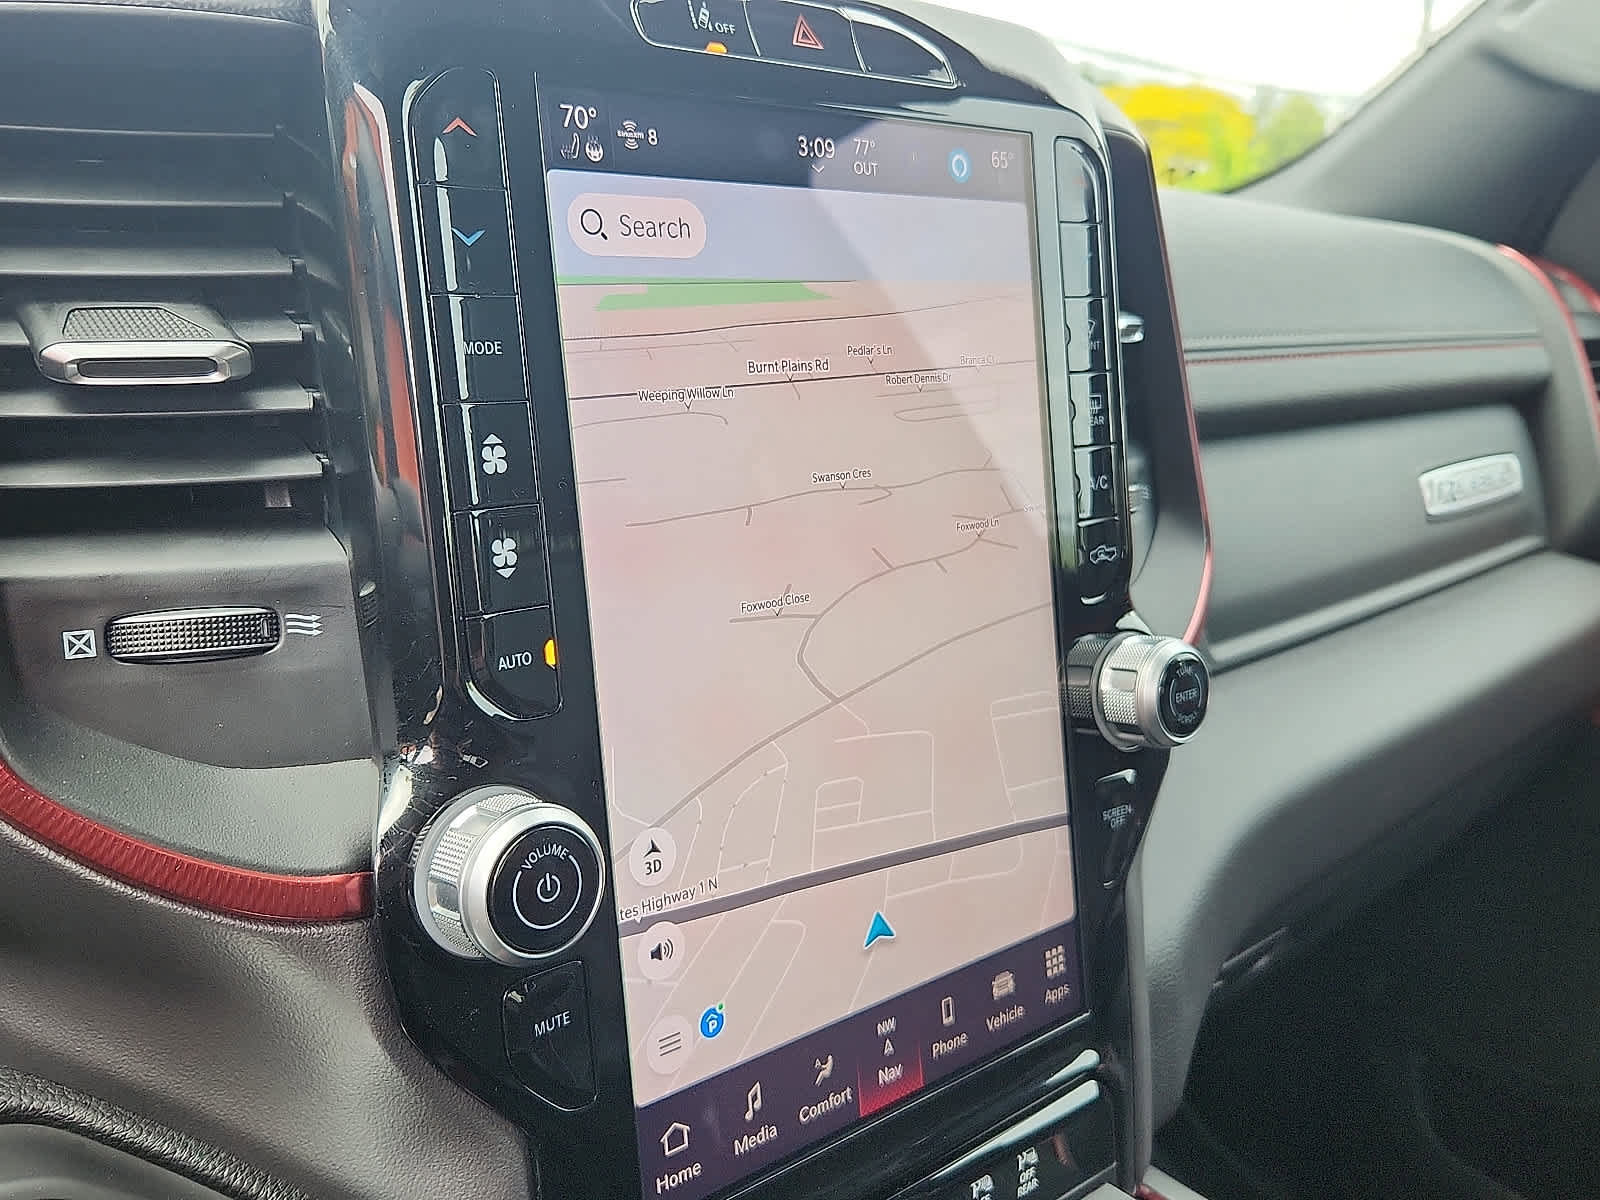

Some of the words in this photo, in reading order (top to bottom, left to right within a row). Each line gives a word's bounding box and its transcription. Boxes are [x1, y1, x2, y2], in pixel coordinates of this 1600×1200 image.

[714, 22, 736, 34] OFF
[647, 128, 658, 146] 8
[797, 135, 836, 159] 3:09
[853, 160, 879, 177] OUT
[619, 214, 691, 239] Search
[463, 341, 503, 355] MODE
[883, 345, 893, 355] Ln
[747, 361, 779, 374] Burnt
[781, 359, 813, 372] Plains
[815, 358, 829, 371] Rd
[885, 375, 913, 385] Robert
[914, 373, 942, 384] Dennis
[638, 389, 685, 403] Weeping
[686, 387, 722, 399] Willow
[722, 387, 734, 398] Ln
[812, 471, 851, 483] Swanson
[852, 469, 872, 479] Cres
[956, 519, 989, 532] Foxwood
[990, 518, 1000, 528] Ln
[741, 596, 784, 614] Foxwood
[785, 593, 811, 606] Close
[498, 651, 532, 671] AUTO
[1175, 687, 1198, 704] ENTER
[1102, 804, 1129, 821] SCREEN
[1110, 815, 1127, 829] OFF
[521, 843, 570, 870] VOLUME
[644, 858, 662, 876] 3D
[641, 886, 696, 913] Highway
[708, 876, 719, 891] N
[1044, 984, 1070, 1004] Apps
[534, 1011, 571, 1037] MUTE
[877, 1016, 897, 1036] NW
[986, 1004, 1025, 1032] Vehicle
[932, 1032, 968, 1060] Phone
[877, 1063, 902, 1087] Nav
[798, 1086, 853, 1125] Comfort
[733, 1124, 778, 1156] Media
[656, 1161, 703, 1194] Home
[1019, 1166, 1037, 1184] OFF
